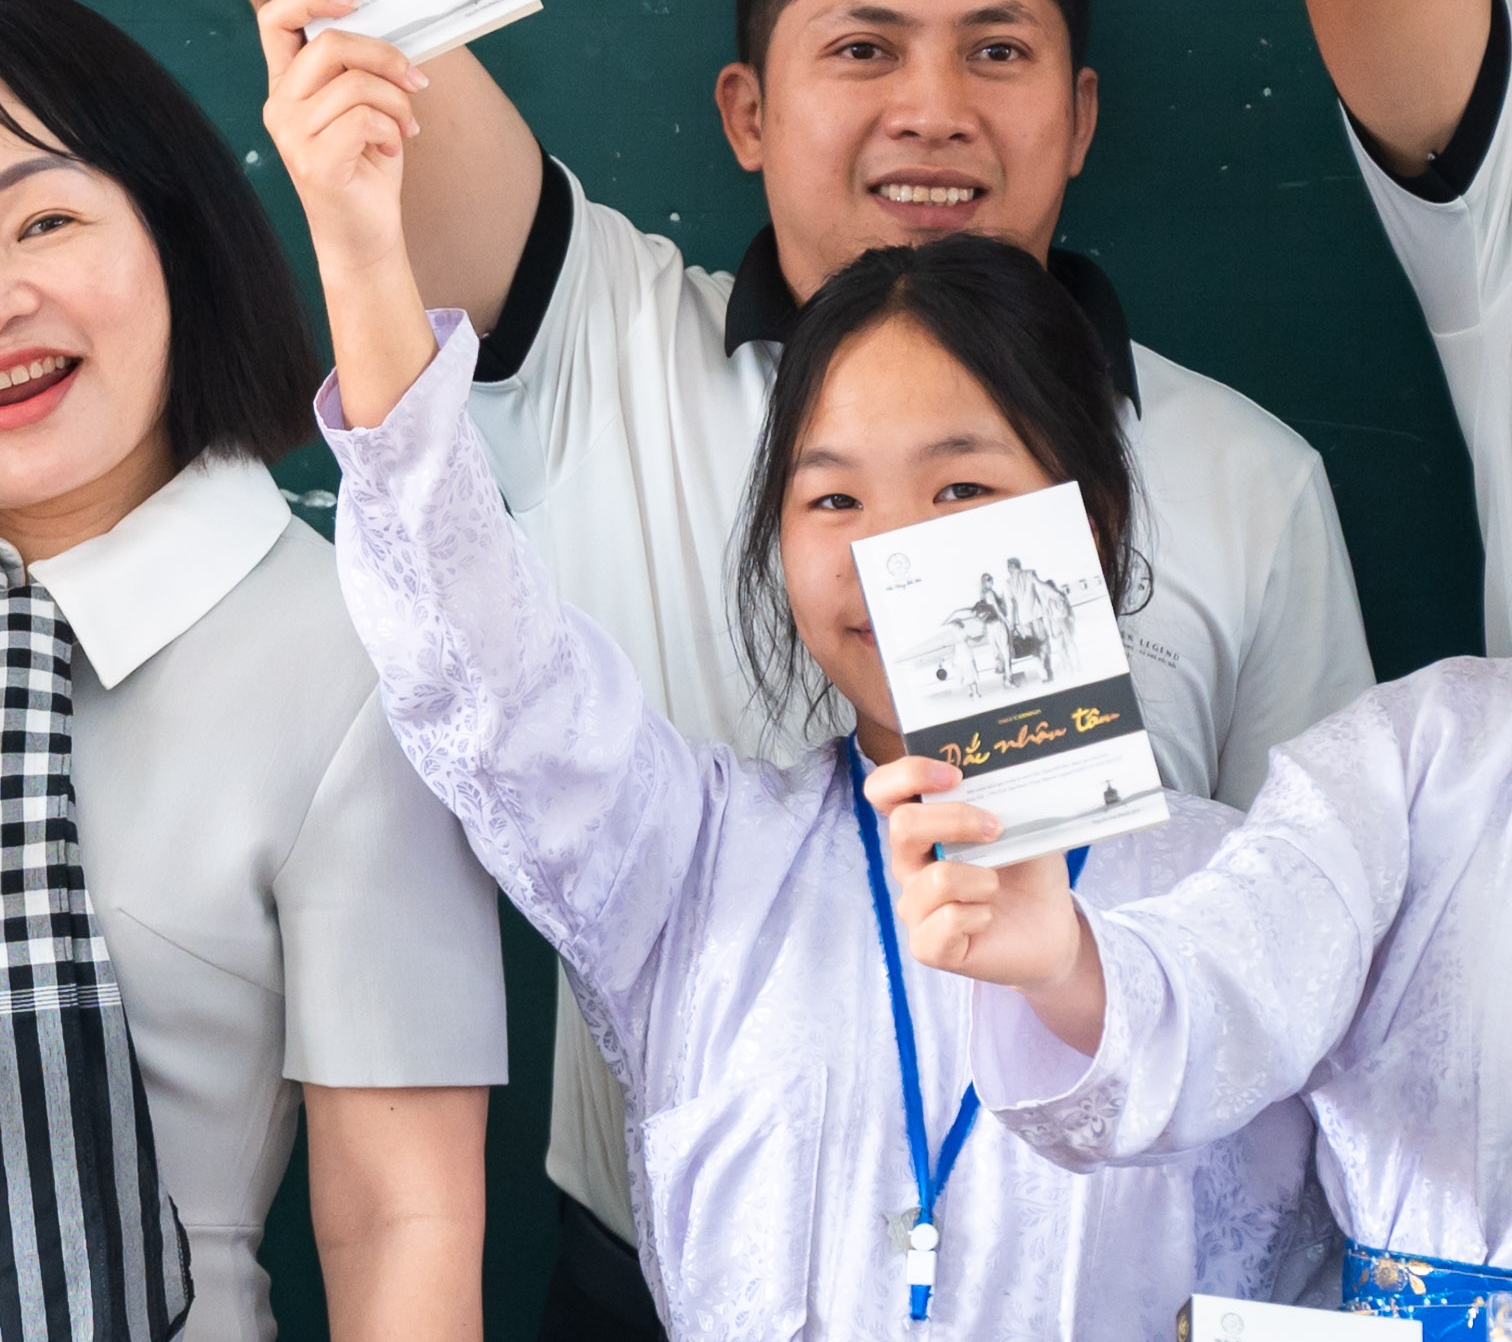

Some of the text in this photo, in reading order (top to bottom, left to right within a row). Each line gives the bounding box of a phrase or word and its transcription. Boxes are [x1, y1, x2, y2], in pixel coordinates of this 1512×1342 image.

[1139, 638, 1180, 661] LEGEND
[994, 720, 1067, 753] nhân
[1071, 707, 1120, 732] tâm
